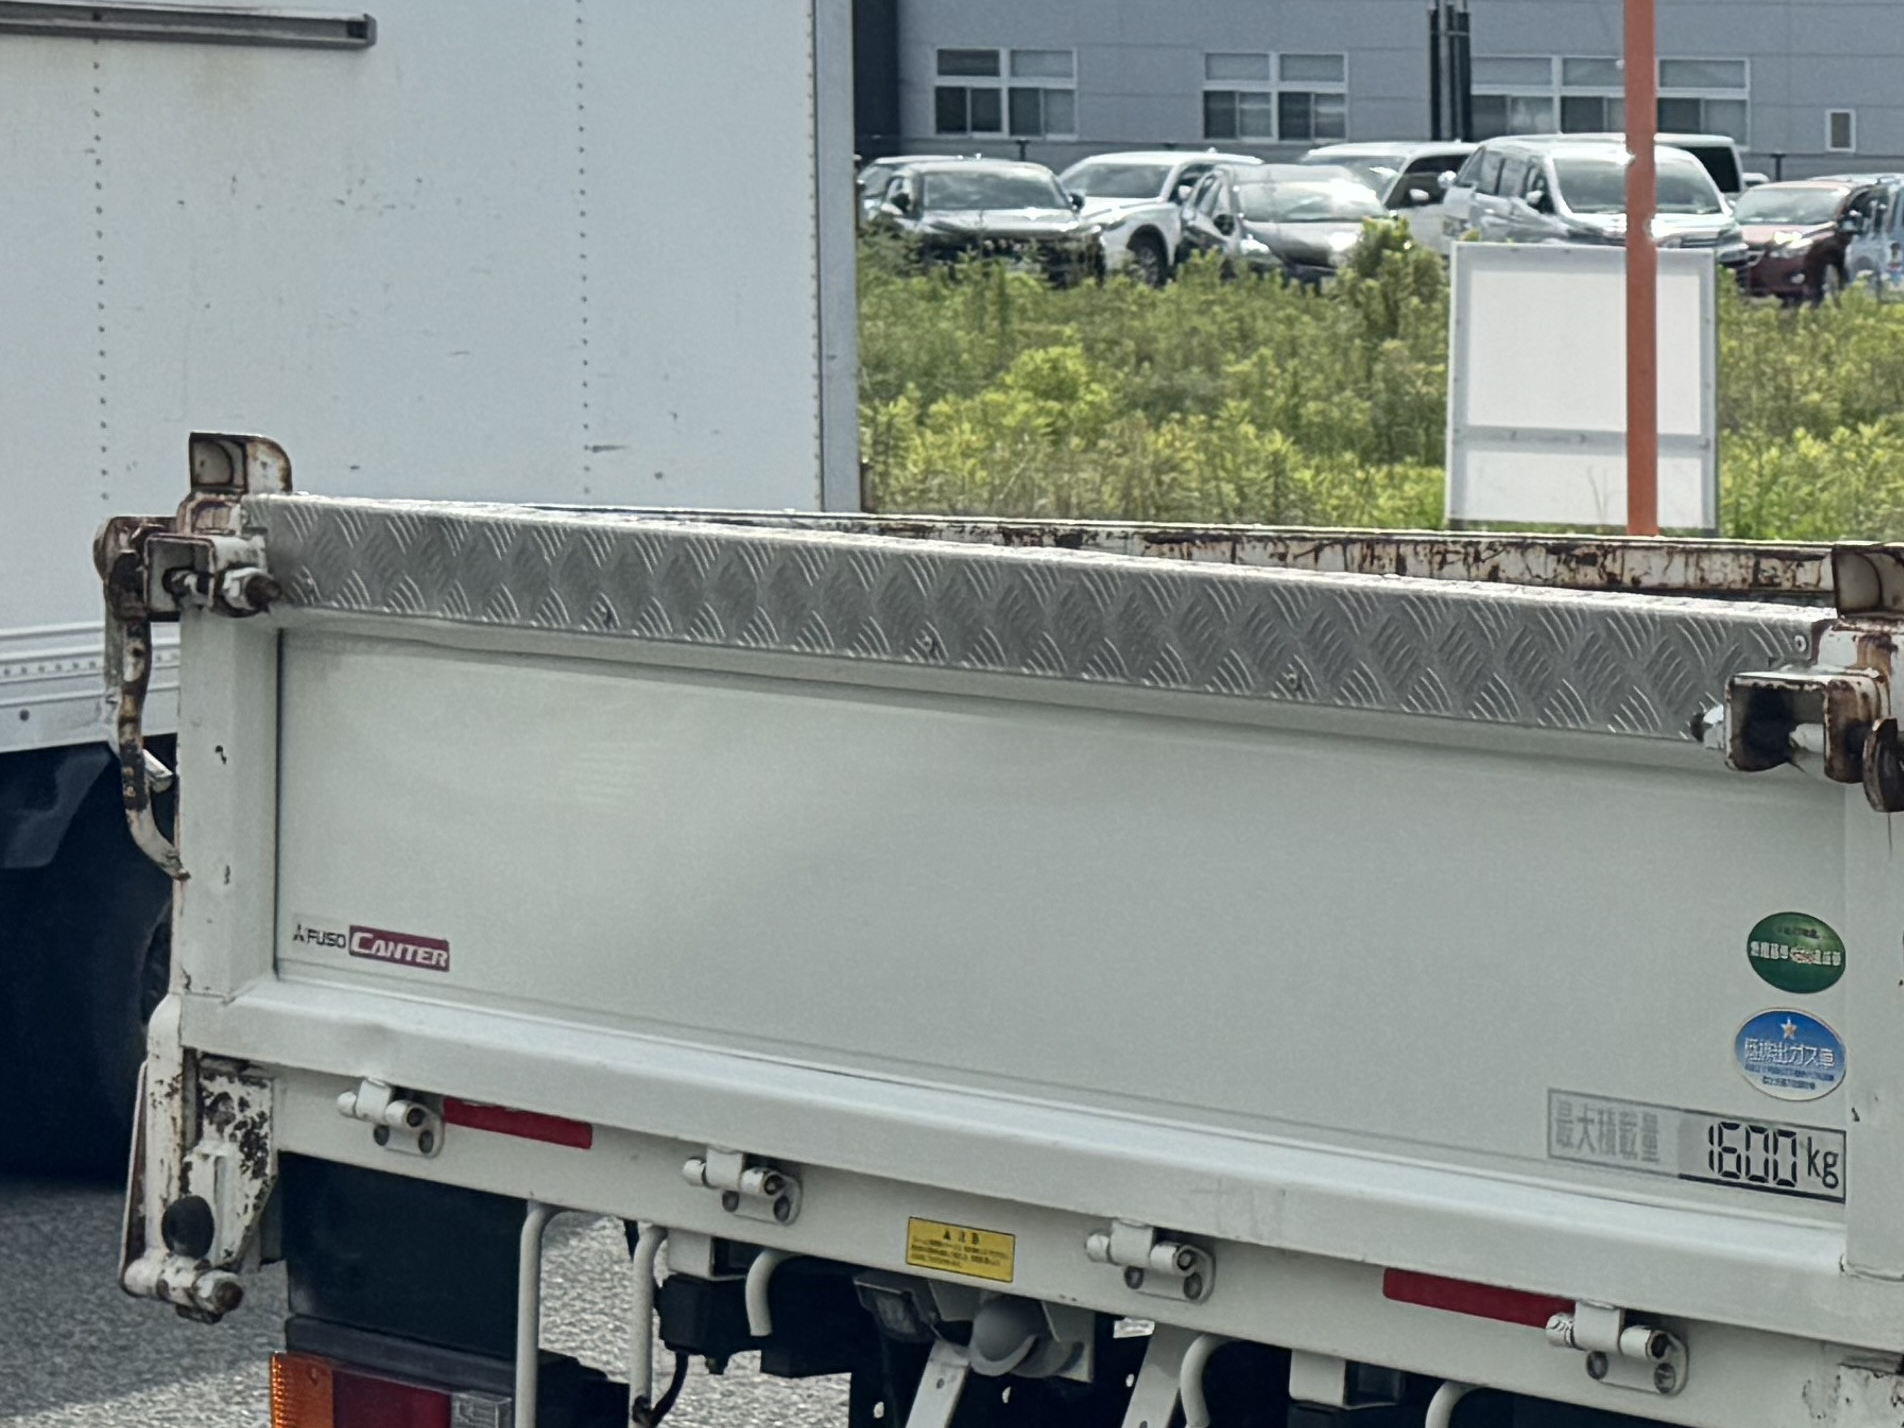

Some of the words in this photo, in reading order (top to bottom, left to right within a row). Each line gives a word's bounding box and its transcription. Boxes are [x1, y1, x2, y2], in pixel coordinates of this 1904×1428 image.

[307, 928, 347, 950] FUSO
[351, 931, 449, 967] CANTER
[1708, 1121, 1797, 1188] 1600
[1807, 1135, 1840, 1189] kg
